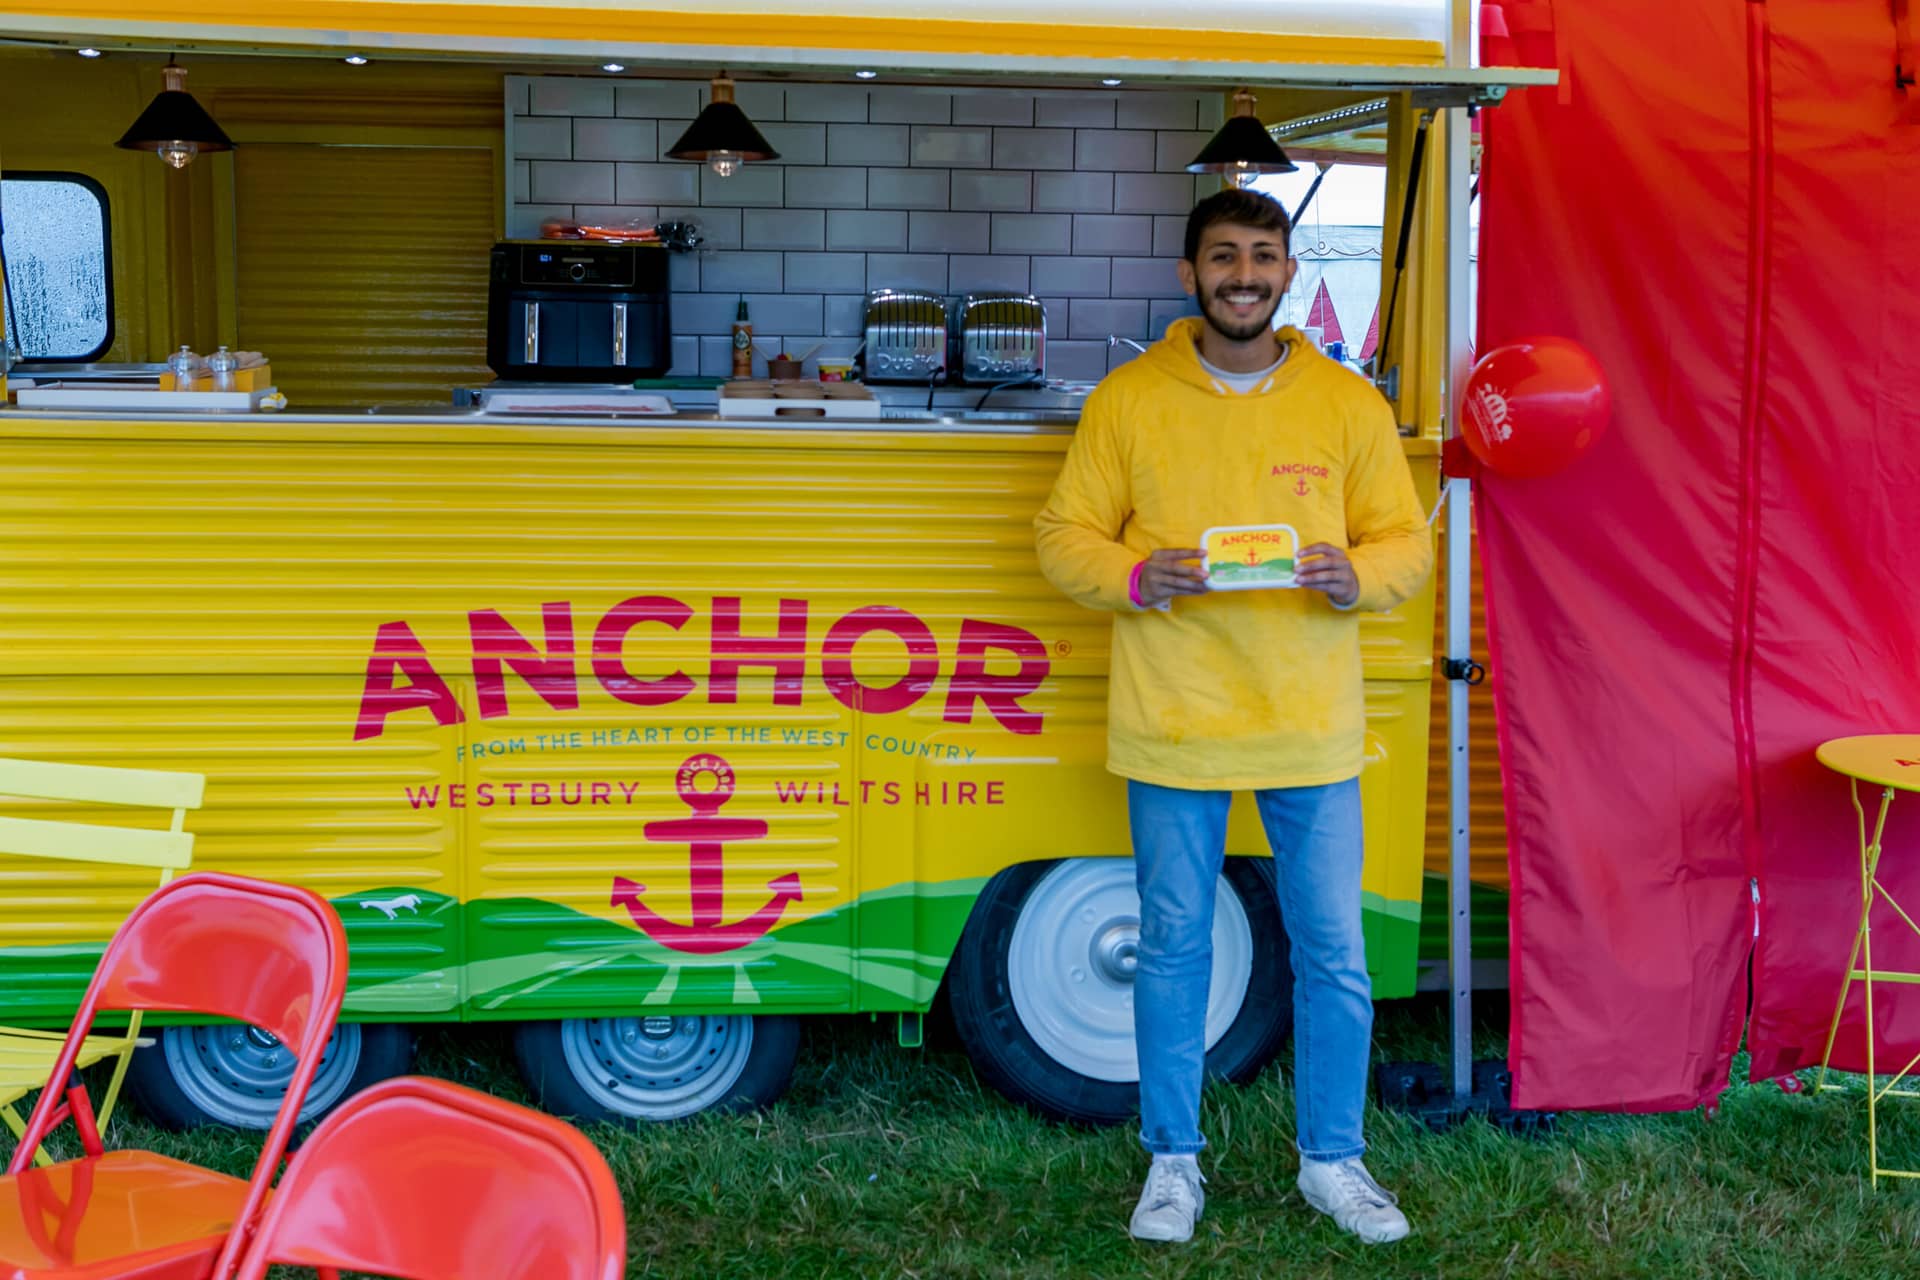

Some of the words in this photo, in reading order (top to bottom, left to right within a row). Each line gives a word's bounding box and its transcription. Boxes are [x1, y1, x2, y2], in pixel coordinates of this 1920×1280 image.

[1271, 463, 1329, 479] ANCHOR
[1221, 532, 1281, 547] ANCHOR
[353, 595, 1050, 742] ANCHOR
[456, 738, 526, 762] FROM
[536, 732, 583, 750] THE
[592, 727, 674, 746] HEART
[684, 726, 715, 743] OF
[726, 727, 771, 743] THE
[782, 729, 849, 747] WEST
[866, 734, 976, 763] COUNTRY
[681, 758, 708, 793] SINCE
[404, 782, 640, 810] WESTBURY
[775, 780, 1005, 806] WILTSHIRE
